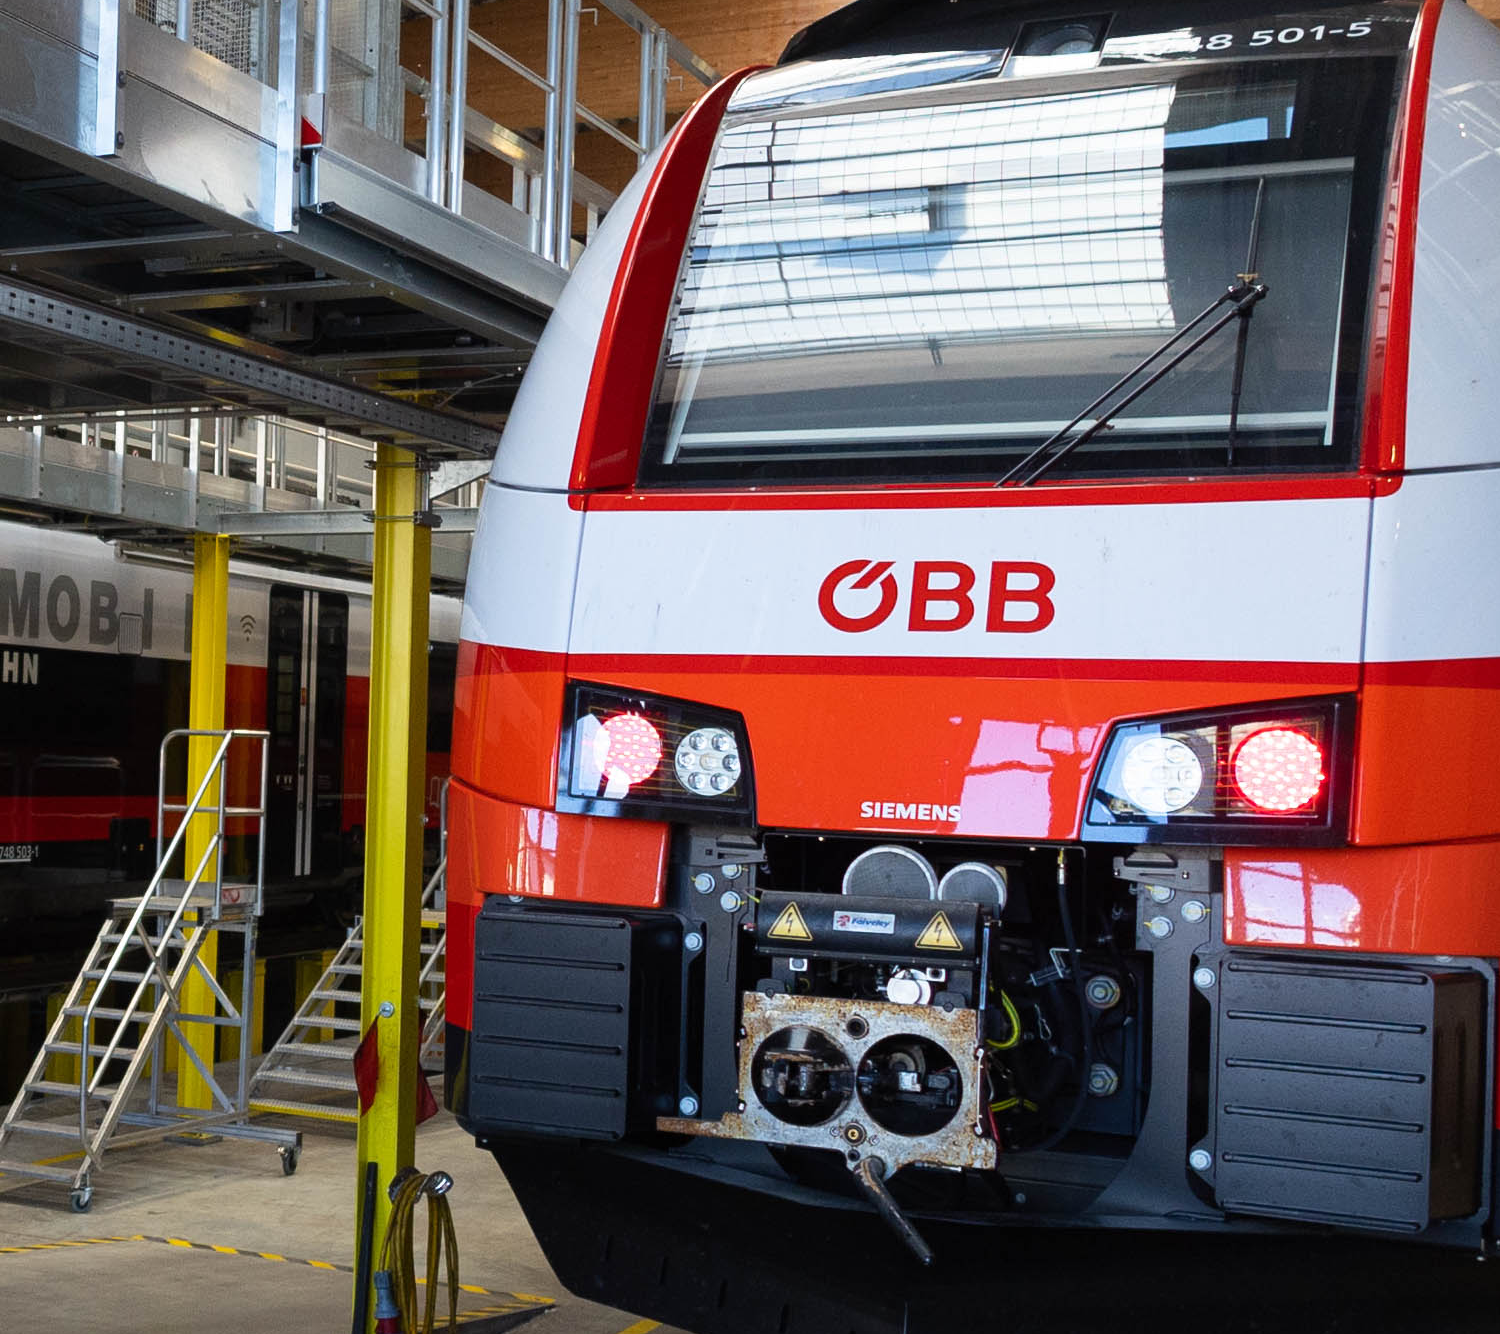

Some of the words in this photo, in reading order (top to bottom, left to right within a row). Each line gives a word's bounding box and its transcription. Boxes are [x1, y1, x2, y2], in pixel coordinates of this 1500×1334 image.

[1248, 20, 1373, 47] 501-5
[817, 559, 1056, 634] ÖBB
[860, 801, 962, 822] SIEMENS
